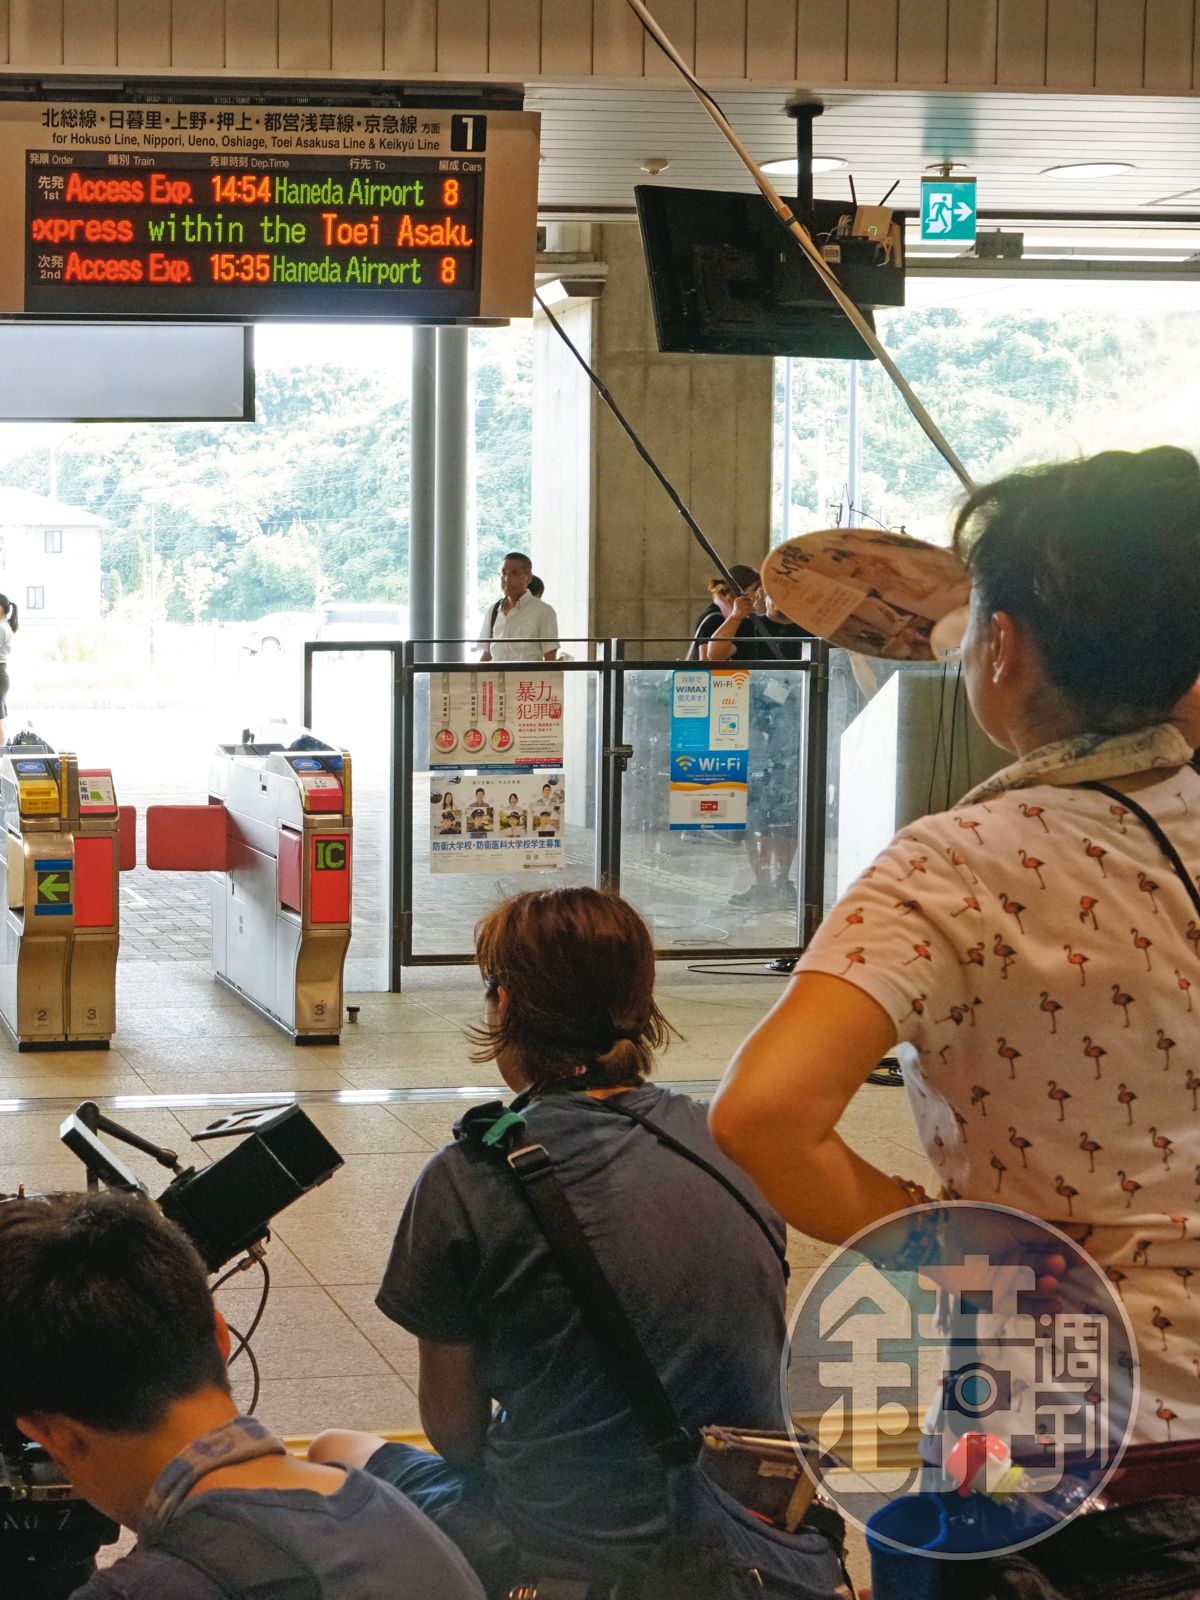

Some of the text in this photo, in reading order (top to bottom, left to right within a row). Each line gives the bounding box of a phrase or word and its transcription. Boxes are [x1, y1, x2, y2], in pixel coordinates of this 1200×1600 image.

[421, 123, 441, 134] 方面
[462, 117, 474, 150] 1
[52, 133, 68, 144] for
[115, 134, 140, 146] Line,
[143, 134, 184, 148] Nippori,
[188, 135, 218, 148] Ueno,
[222, 135, 268, 150] Oshiage,
[271, 136, 293, 148] Toei
[295, 137, 340, 149] Asakusa
[343, 138, 365, 149] Line
[368, 138, 376, 149] &
[417, 139, 440, 150] Line
[52, 155, 74, 165] Order
[108, 154, 155, 167] 種別 Train
[210, 156, 248, 168] 発車時刻
[349, 158, 386, 170] 行先 To
[462, 161, 482, 172] Cars
[38, 175, 64, 189] 先発
[43, 190, 59, 201] 1st
[66, 172, 460, 208] Access Exp. 14:54 Haneda Airport 8
[149, 213, 243, 243] within
[260, 215, 306, 244] the
[321, 213, 380, 246] Toei
[37, 255, 64, 269] 次発
[64, 251, 457, 285] Access Exp. 15:35 Haneda Airport 8
[40, 269, 61, 280] 2nd
[712, 680, 733, 688] Wi-Fi
[698, 757, 741, 771] Wi-Fi
[316, 842, 345, 869] IC
[37, 1009, 47, 1021] 2
[87, 1008, 97, 1021] 3
